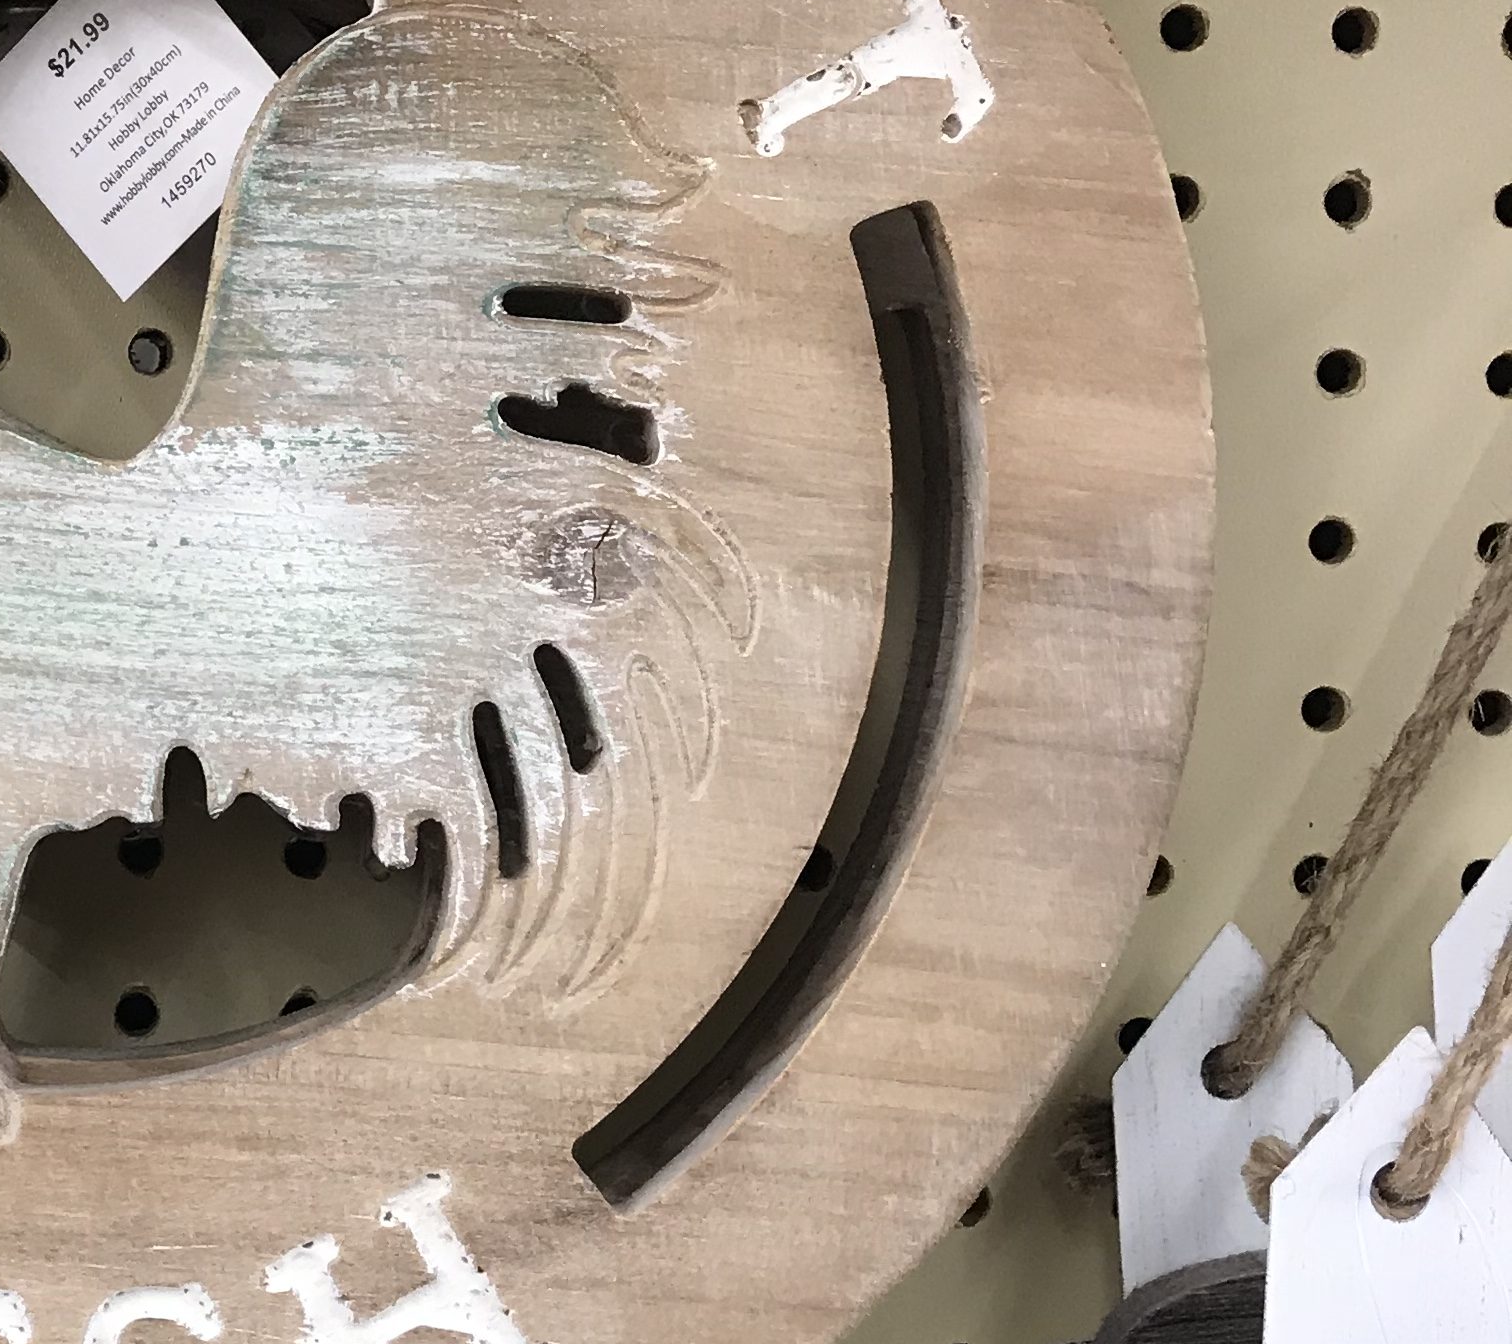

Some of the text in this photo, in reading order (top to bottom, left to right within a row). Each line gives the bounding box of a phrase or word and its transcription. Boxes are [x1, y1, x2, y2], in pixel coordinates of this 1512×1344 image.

[48, 12, 110, 77] $21.99
[70, 44, 182, 158] 11.81x15.75in(30x40cm)
[73, 46, 136, 110] Home Decor
[206, 109, 217, 120] in
[214, 86, 241, 112] China
[99, 145, 147, 193] Oklahoma
[176, 82, 209, 115] 73179
[108, 90, 169, 151] Hobby Lobby
[161, 152, 216, 208] 1459270
